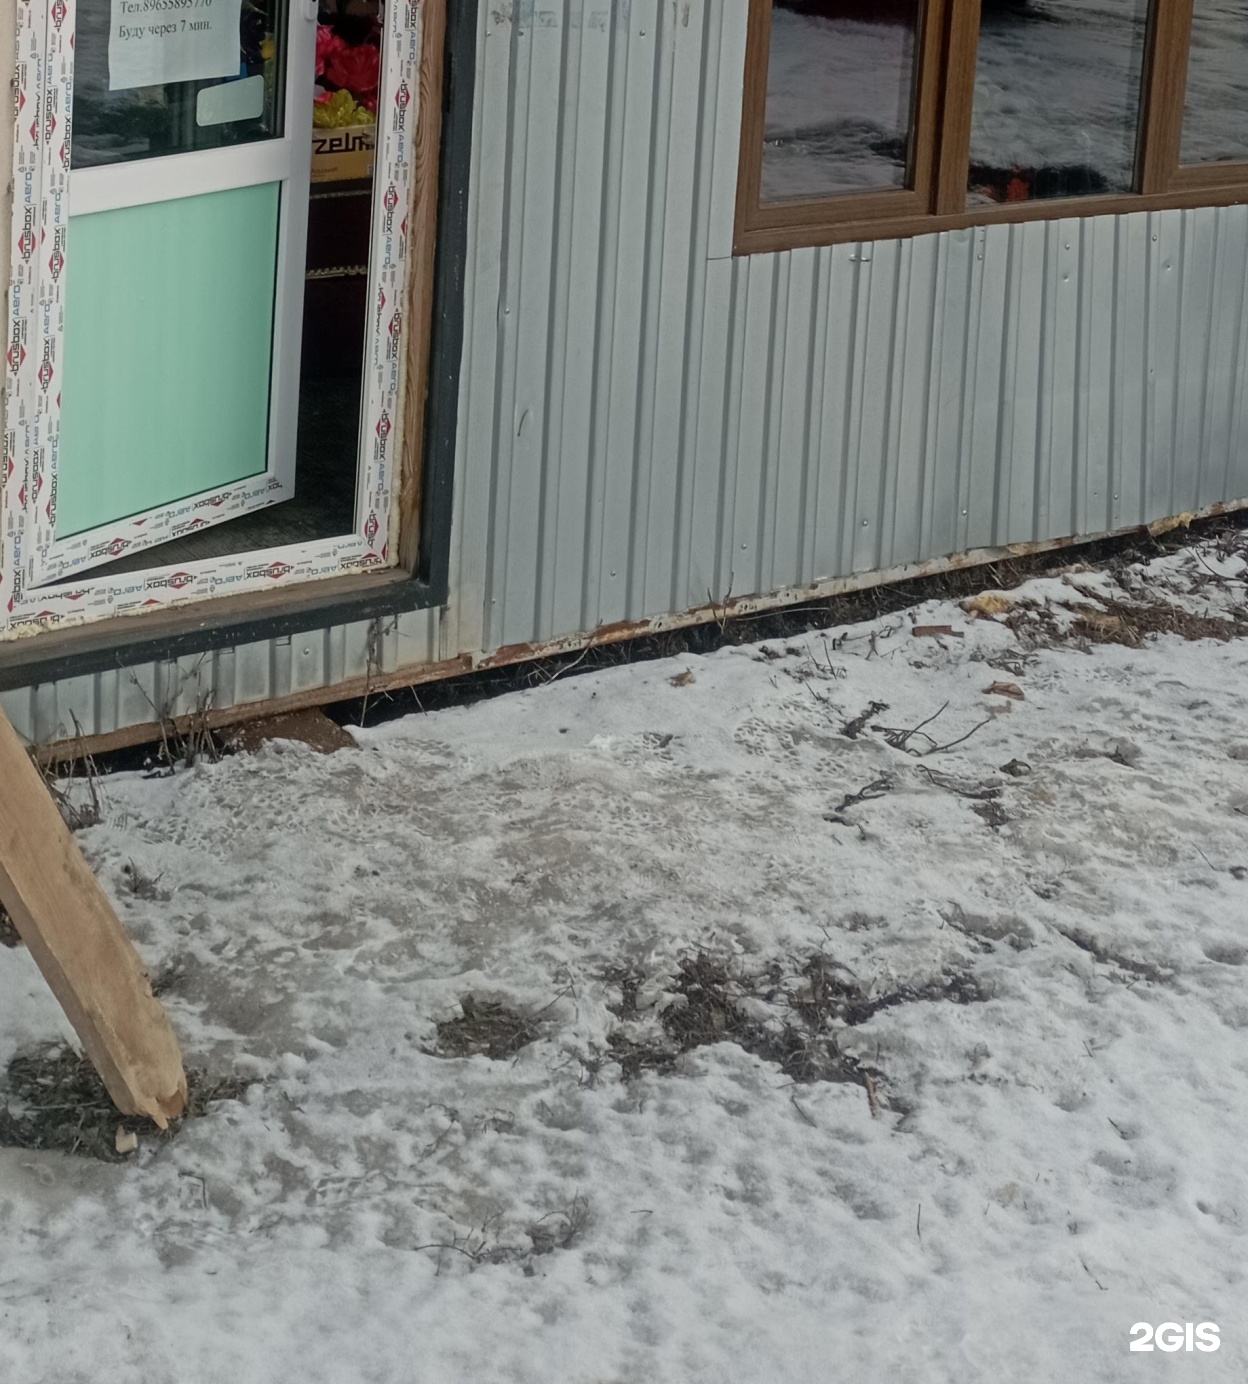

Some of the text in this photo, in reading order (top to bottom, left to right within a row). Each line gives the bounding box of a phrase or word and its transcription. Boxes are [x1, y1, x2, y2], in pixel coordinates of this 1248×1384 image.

[119, 19, 212, 41] Буду через 7 мин.
